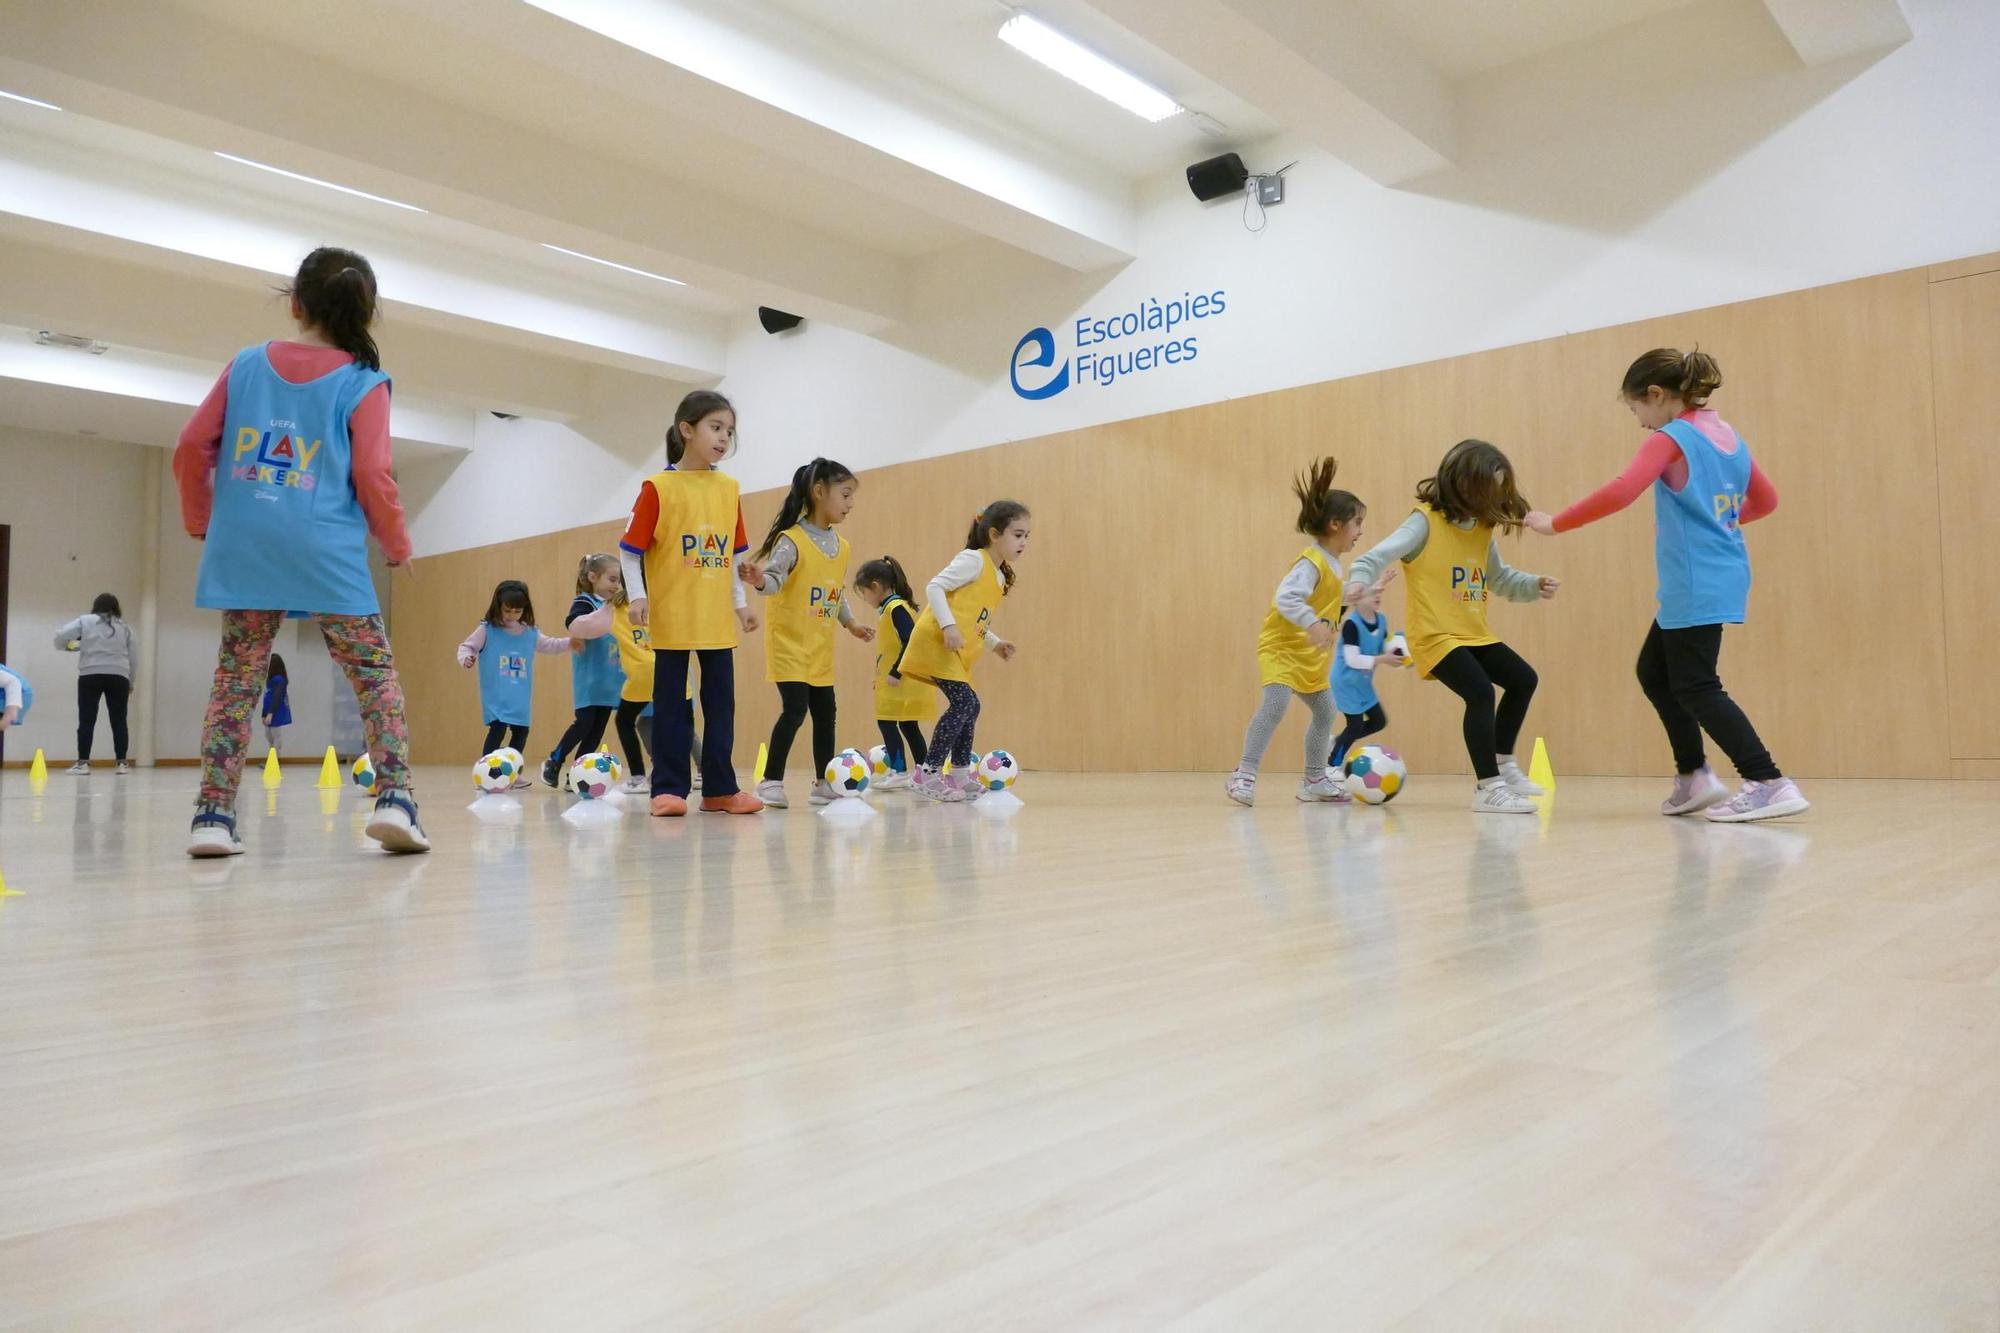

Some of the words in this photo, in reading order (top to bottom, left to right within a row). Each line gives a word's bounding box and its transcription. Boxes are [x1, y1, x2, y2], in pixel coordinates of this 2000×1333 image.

[1076, 290, 1226, 347] Escolàpies
[1076, 337, 1198, 386] Figueres
[270, 419, 297, 430] UEFA
[234, 427, 322, 471] PLAY
[231, 464, 316, 491] MAKERS
[682, 533, 728, 556] PLAY
